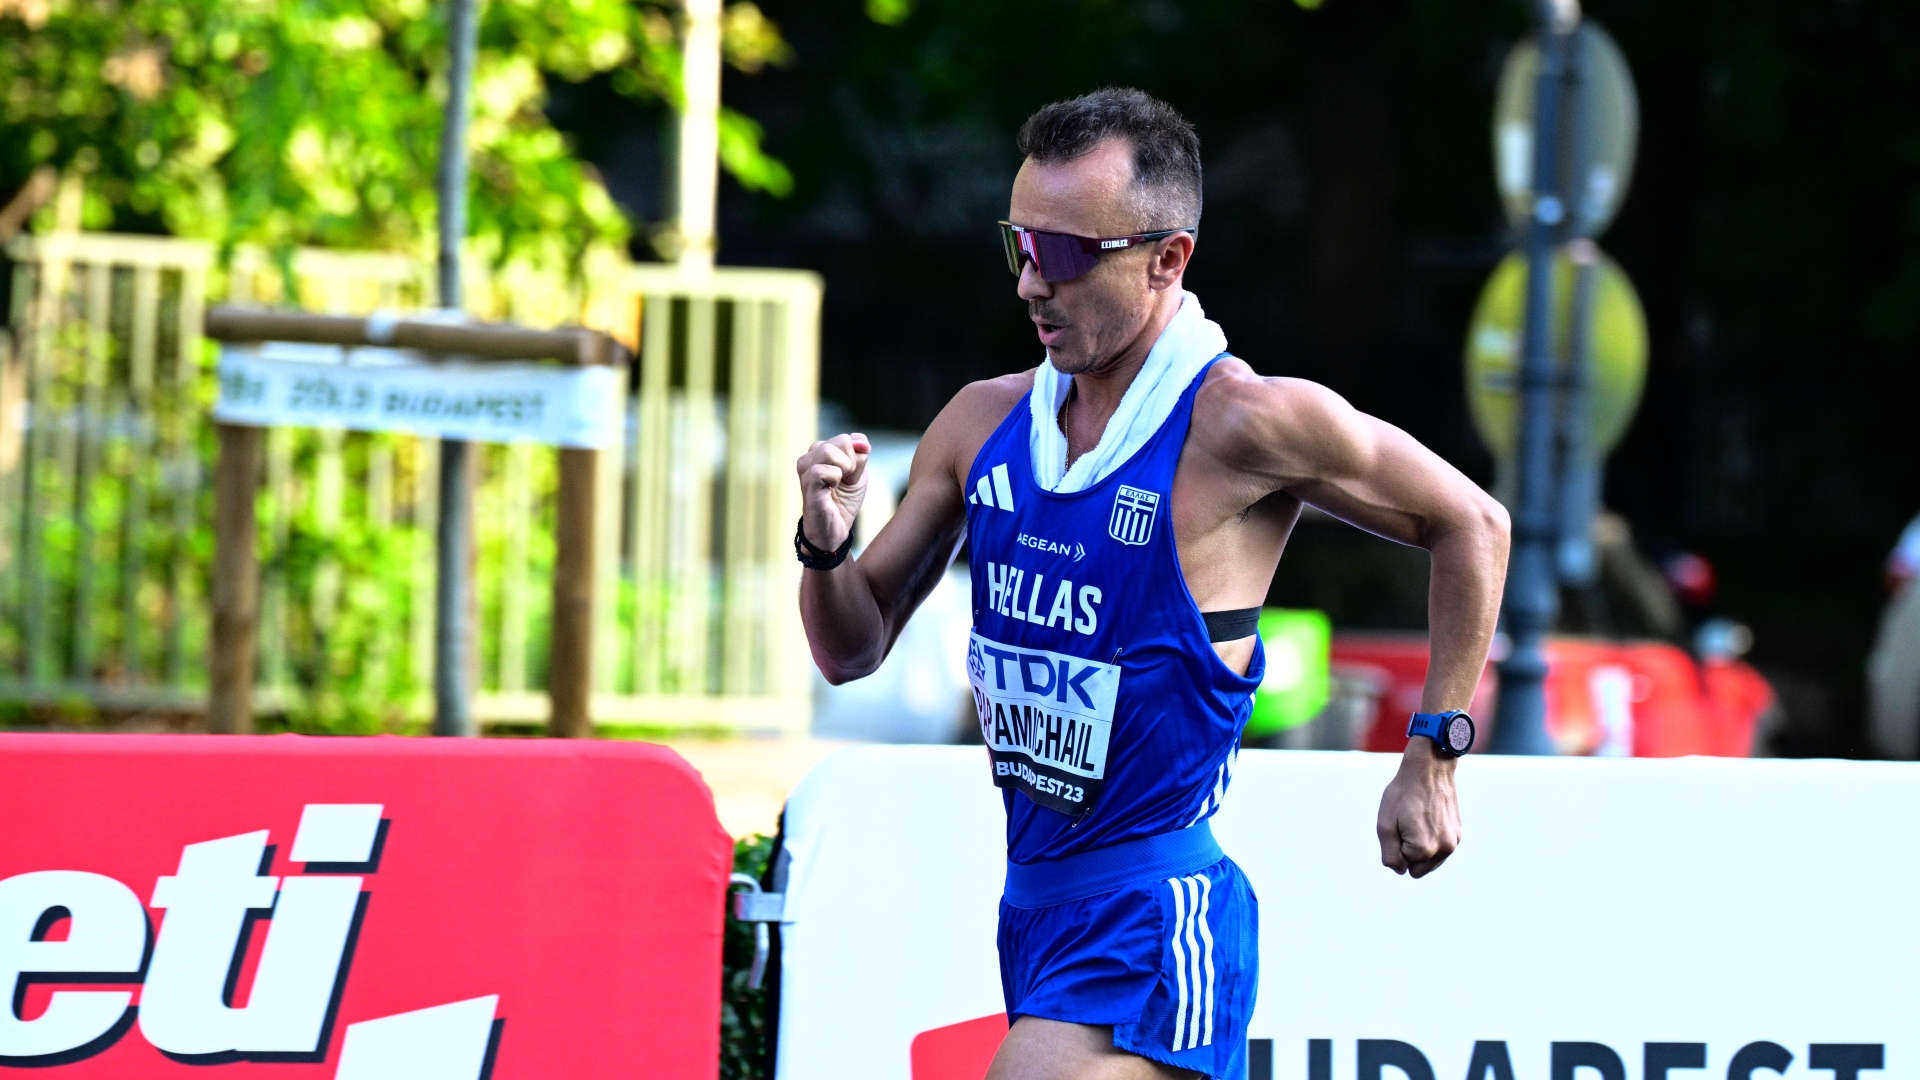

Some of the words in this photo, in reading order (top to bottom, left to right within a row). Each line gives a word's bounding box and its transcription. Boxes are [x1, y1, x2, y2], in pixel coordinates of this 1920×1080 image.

[1017, 532, 1071, 556] AEGEAN
[987, 562, 1103, 636] HELLAS
[984, 644, 1102, 711] TDK
